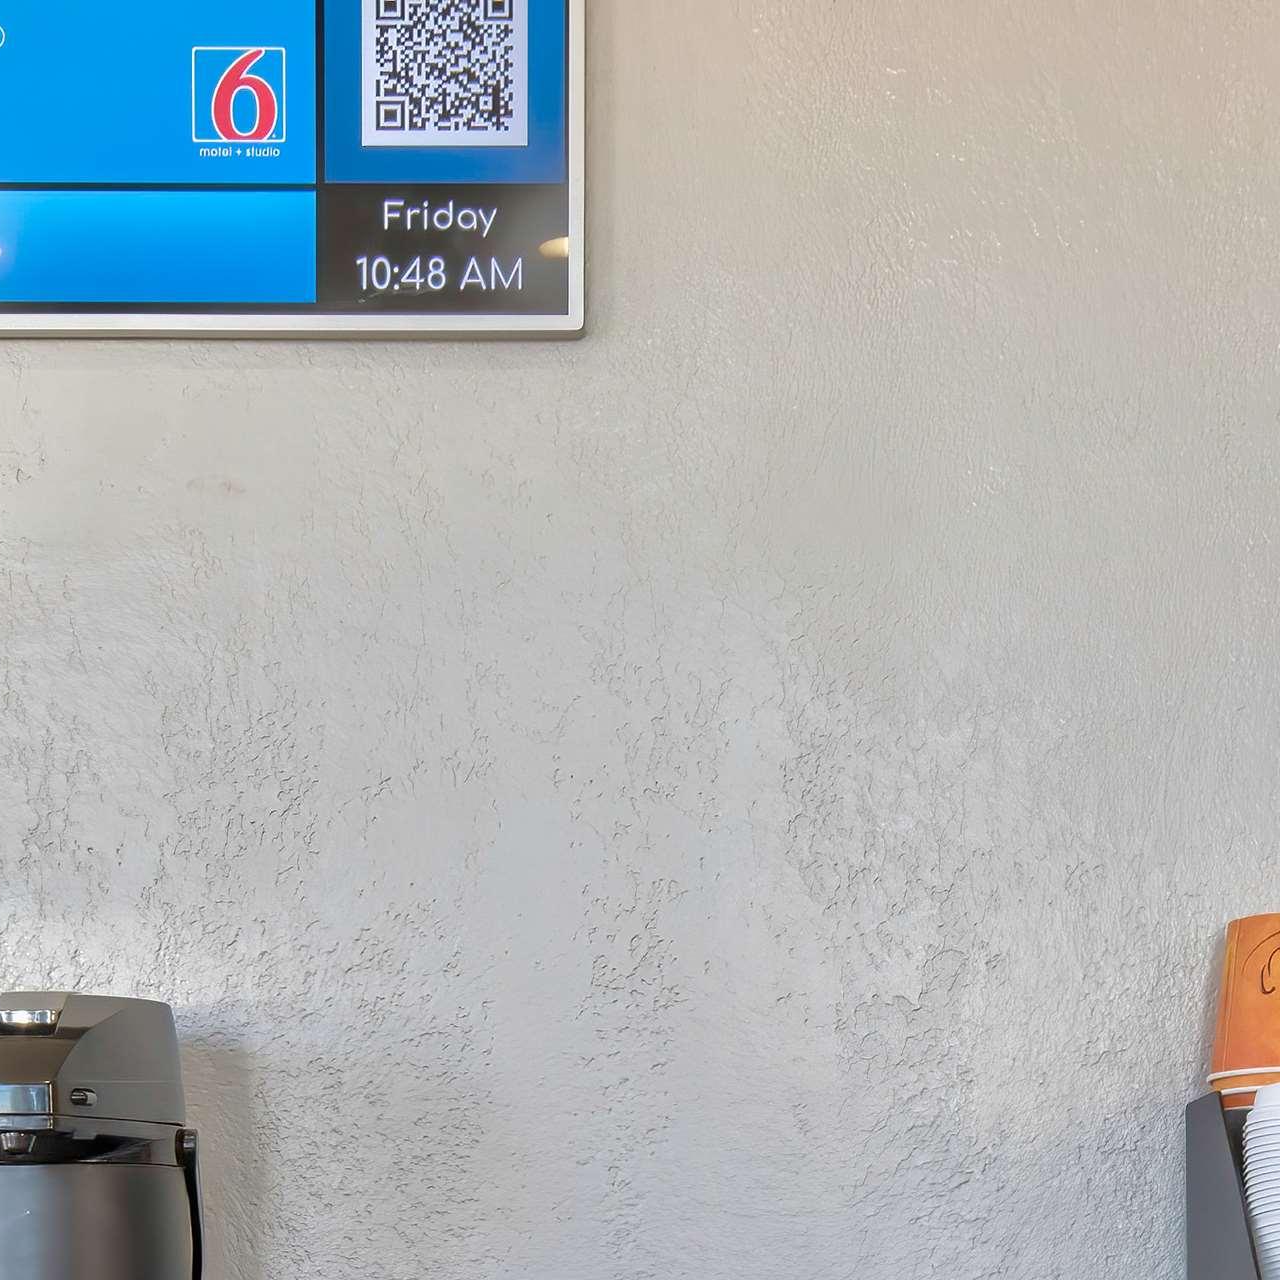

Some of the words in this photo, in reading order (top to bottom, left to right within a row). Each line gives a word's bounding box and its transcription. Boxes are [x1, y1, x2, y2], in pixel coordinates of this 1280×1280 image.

[211, 47, 278, 142] 6
[245, 146, 281, 157] studio
[382, 199, 498, 238] Friday
[355, 255, 447, 290] 10:48
[459, 255, 523, 290] AM
